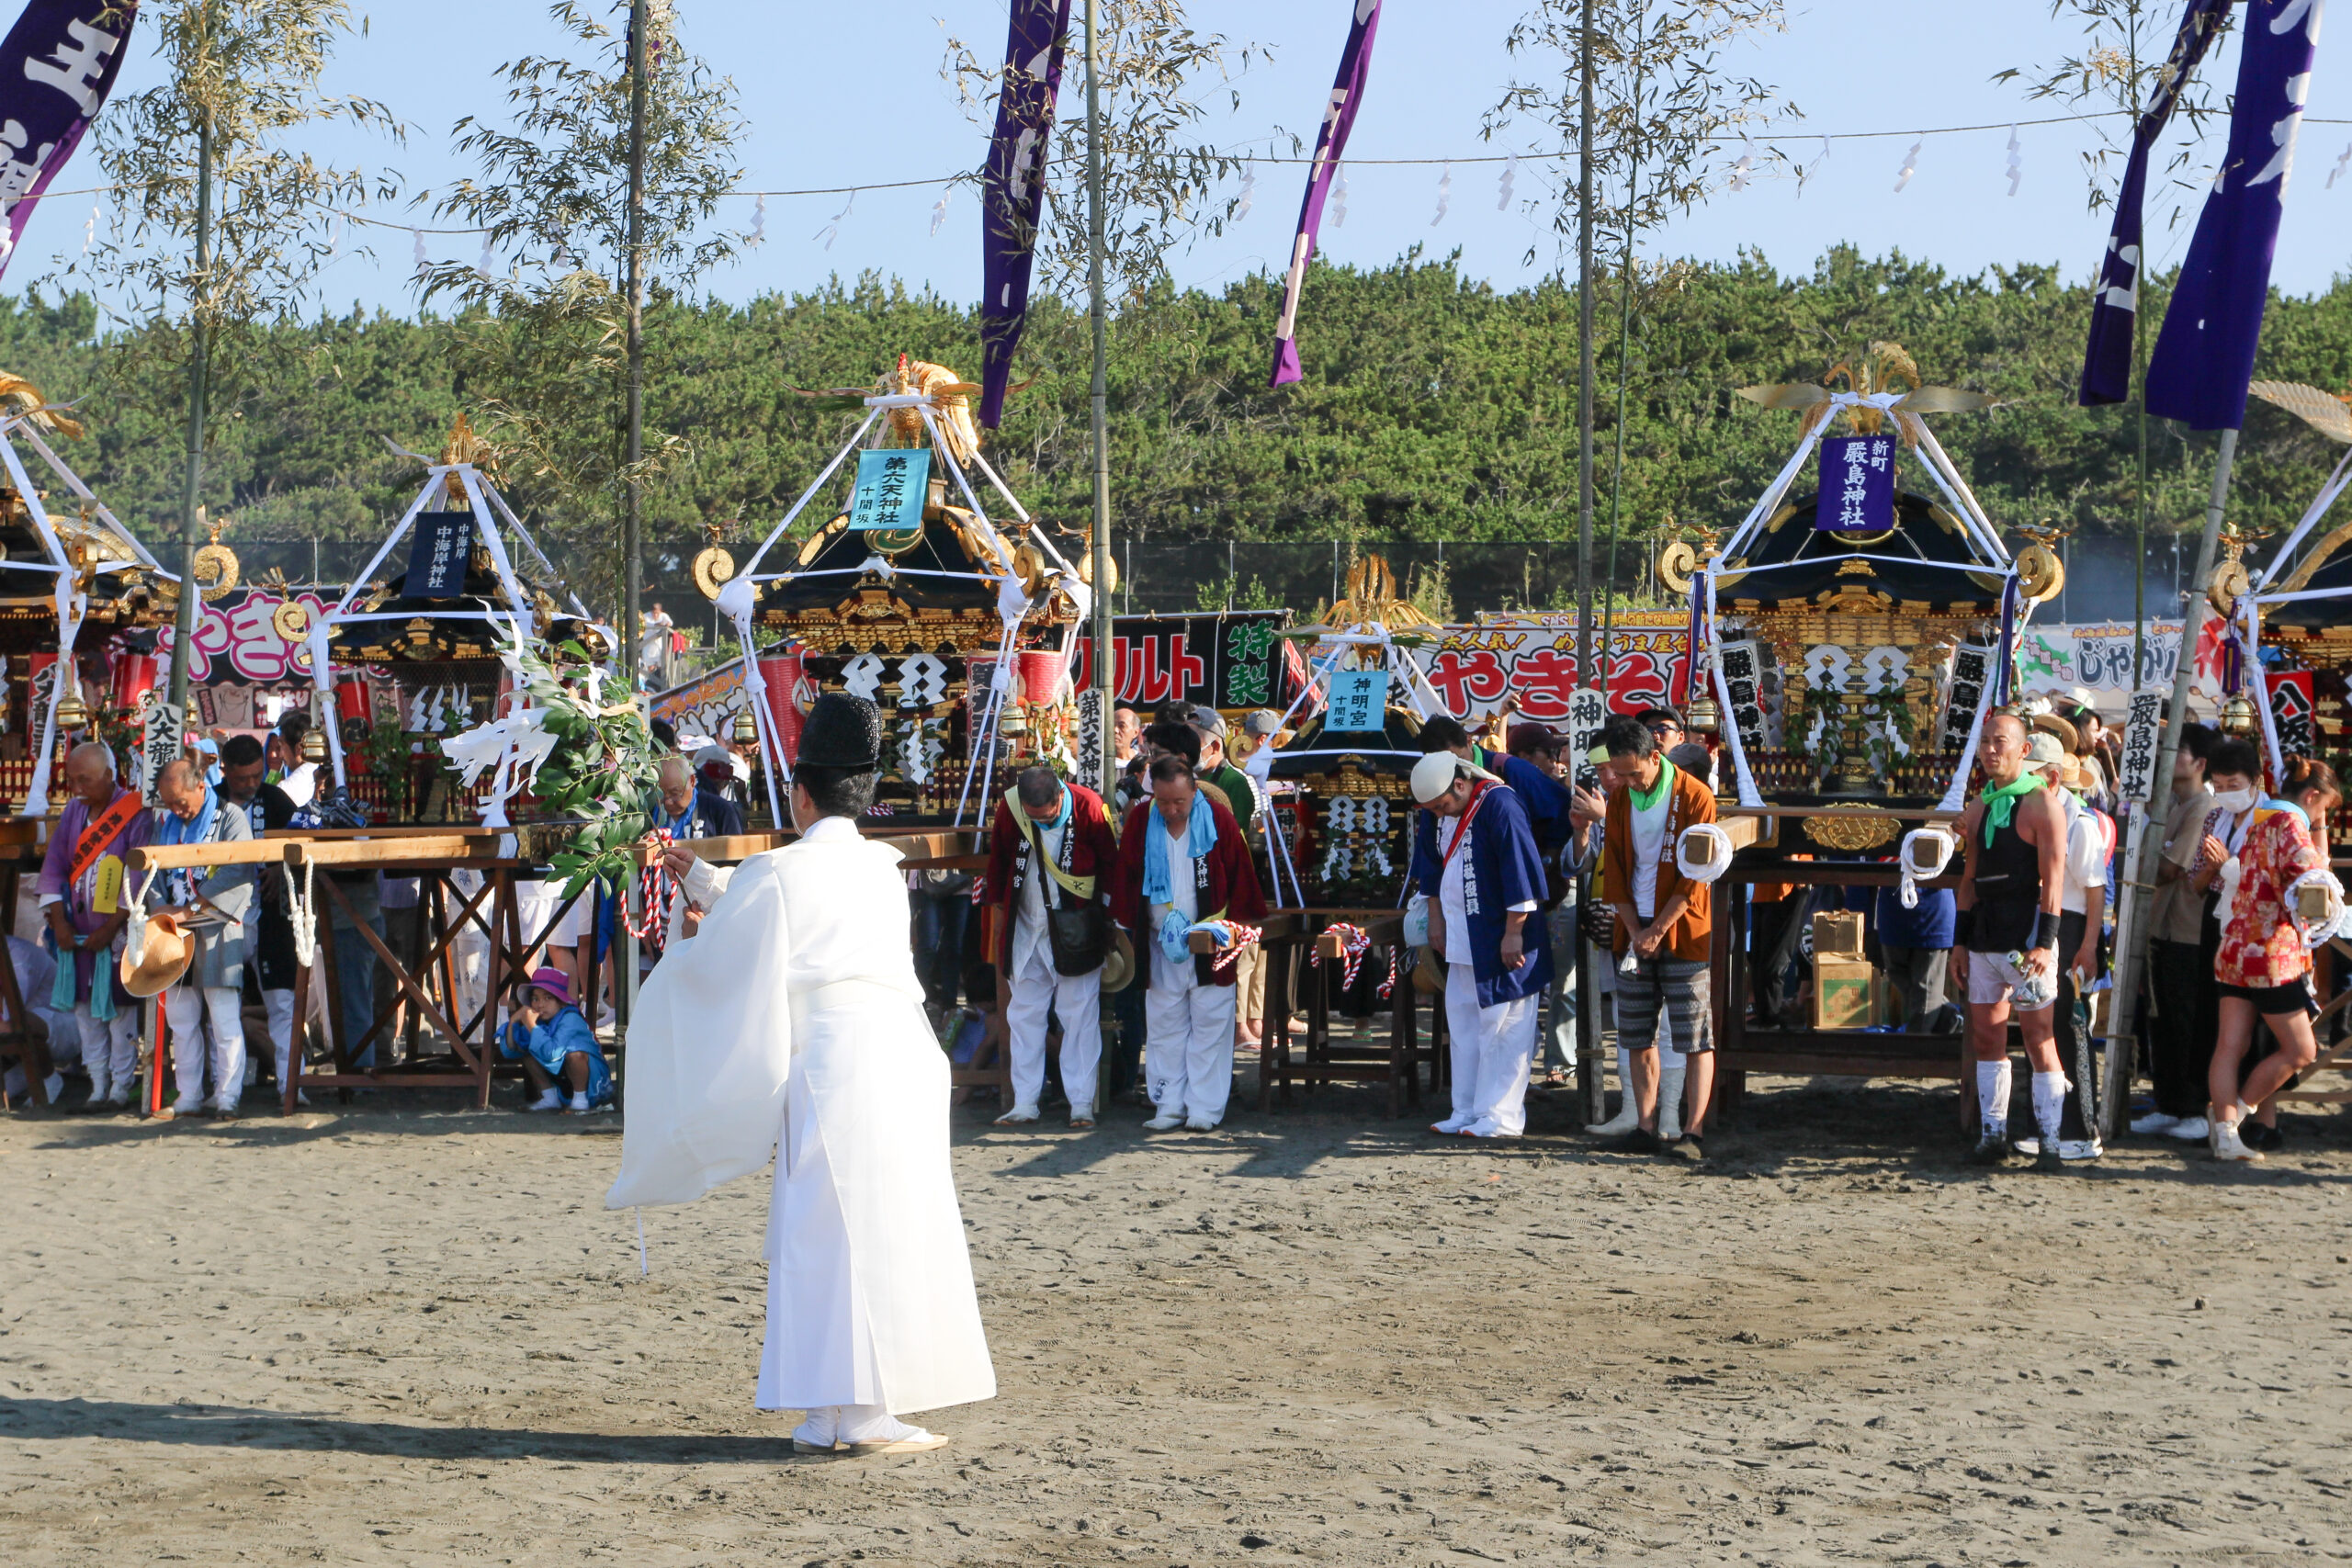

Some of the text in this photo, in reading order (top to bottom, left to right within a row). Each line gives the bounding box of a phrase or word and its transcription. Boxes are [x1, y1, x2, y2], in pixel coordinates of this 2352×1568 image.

[1871, 440, 1889, 472] 新町
[855, 486, 875, 524] 十間坂
[874, 457, 908, 525] 第六天神社
[1838, 441, 1869, 526] 嚴島神社
[426, 525, 453, 588] 中海岸神社
[455, 523, 469, 559] 中海岸
[1227, 618, 1274, 705] 特製
[1553, 633, 1708, 653] めゃうま屋台
[254, 689, 311, 709] やとり
[1333, 695, 1347, 727] 十間坂
[1350, 677, 1371, 726] 神明宮
[2122, 694, 2159, 798] 嚴島神社
[2127, 816, 2138, 859] 新町
[1013, 840, 1030, 888] 神明宮
[1196, 853, 1209, 889] 天神社
[1462, 822, 1480, 917] 島神社役員
